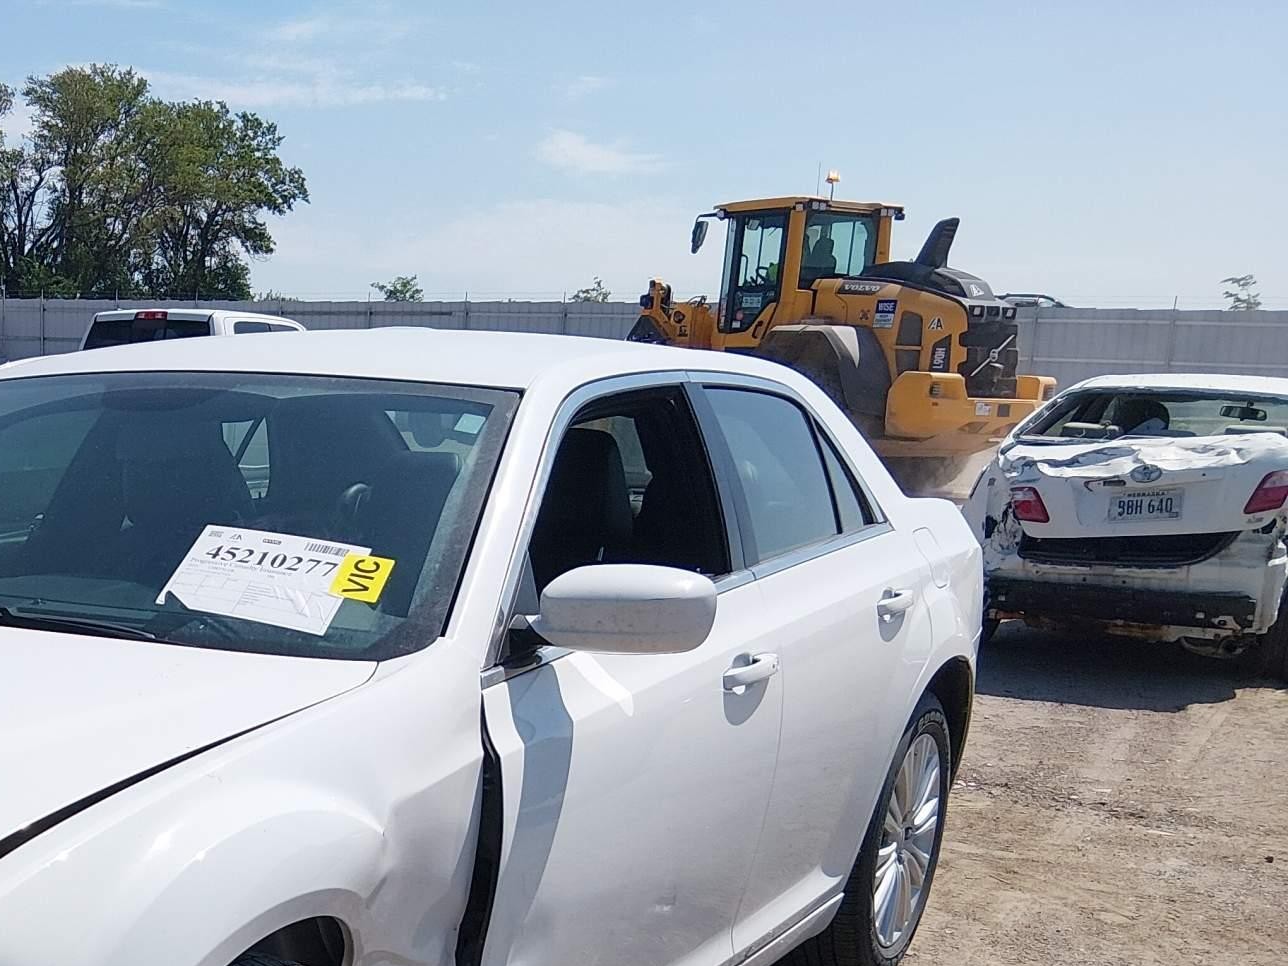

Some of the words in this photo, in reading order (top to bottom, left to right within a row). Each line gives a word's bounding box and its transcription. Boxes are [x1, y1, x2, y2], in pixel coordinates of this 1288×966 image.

[844, 284, 880, 292] VOLVO
[1147, 497, 1173, 514] 640
[206, 544, 339, 577] 45210277
[341, 559, 381, 594] VIC
